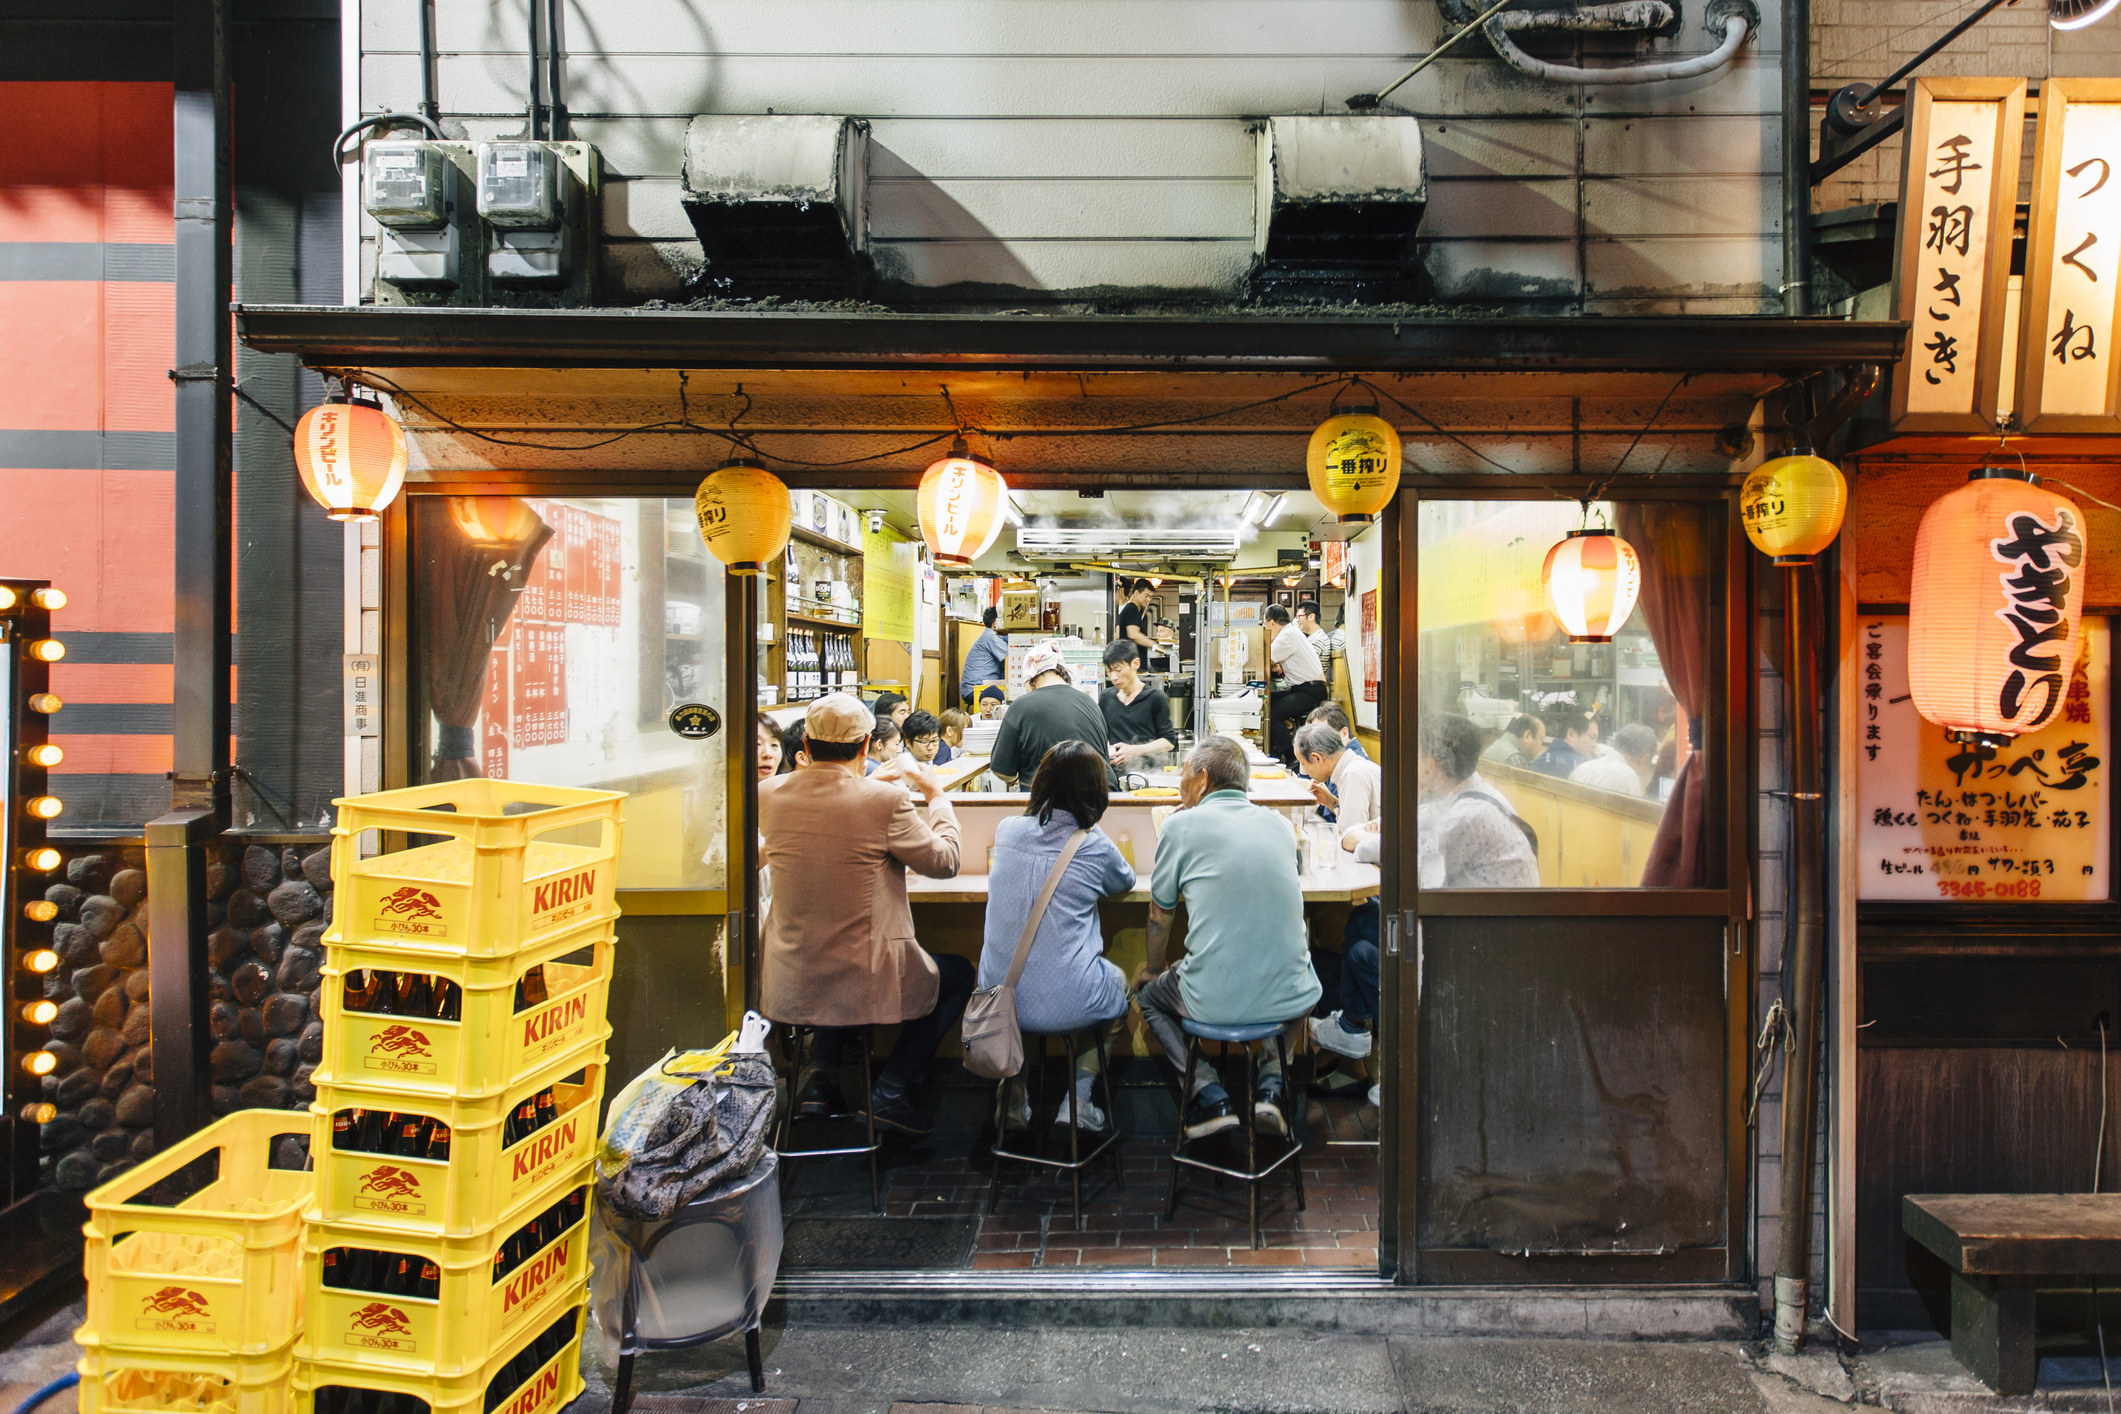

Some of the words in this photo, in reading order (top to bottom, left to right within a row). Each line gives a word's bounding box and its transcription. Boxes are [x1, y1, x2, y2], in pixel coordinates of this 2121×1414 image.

[1924, 134, 1982, 385] 手羽さき
[2051, 157, 2110, 365] つくね
[320, 411, 343, 486] キリンビール
[1325, 458, 1388, 474] 一番搾り
[1996, 509, 2083, 727] やきとり
[350, 660, 371, 730] (有)日進商事
[491, 657, 499, 704] ラーメン
[1864, 621, 1884, 762] ご宴会承ります
[533, 869, 596, 915] KIRIN
[1881, 858, 1924, 875] 生ビール
[1936, 878, 2042, 898] 3345-0188
[391, 922, 430, 934] 小びん30本
[523, 992, 587, 1048] KIRIN
[380, 1060, 419, 1072] 小びん30本
[512, 1117, 577, 1183] KIRIN
[369, 1199, 409, 1212] 小びん30本
[503, 1239, 569, 1314] KIRIN
[361, 1337, 400, 1349] 小びん30本
[505, 1362, 559, 1414] IRIN
